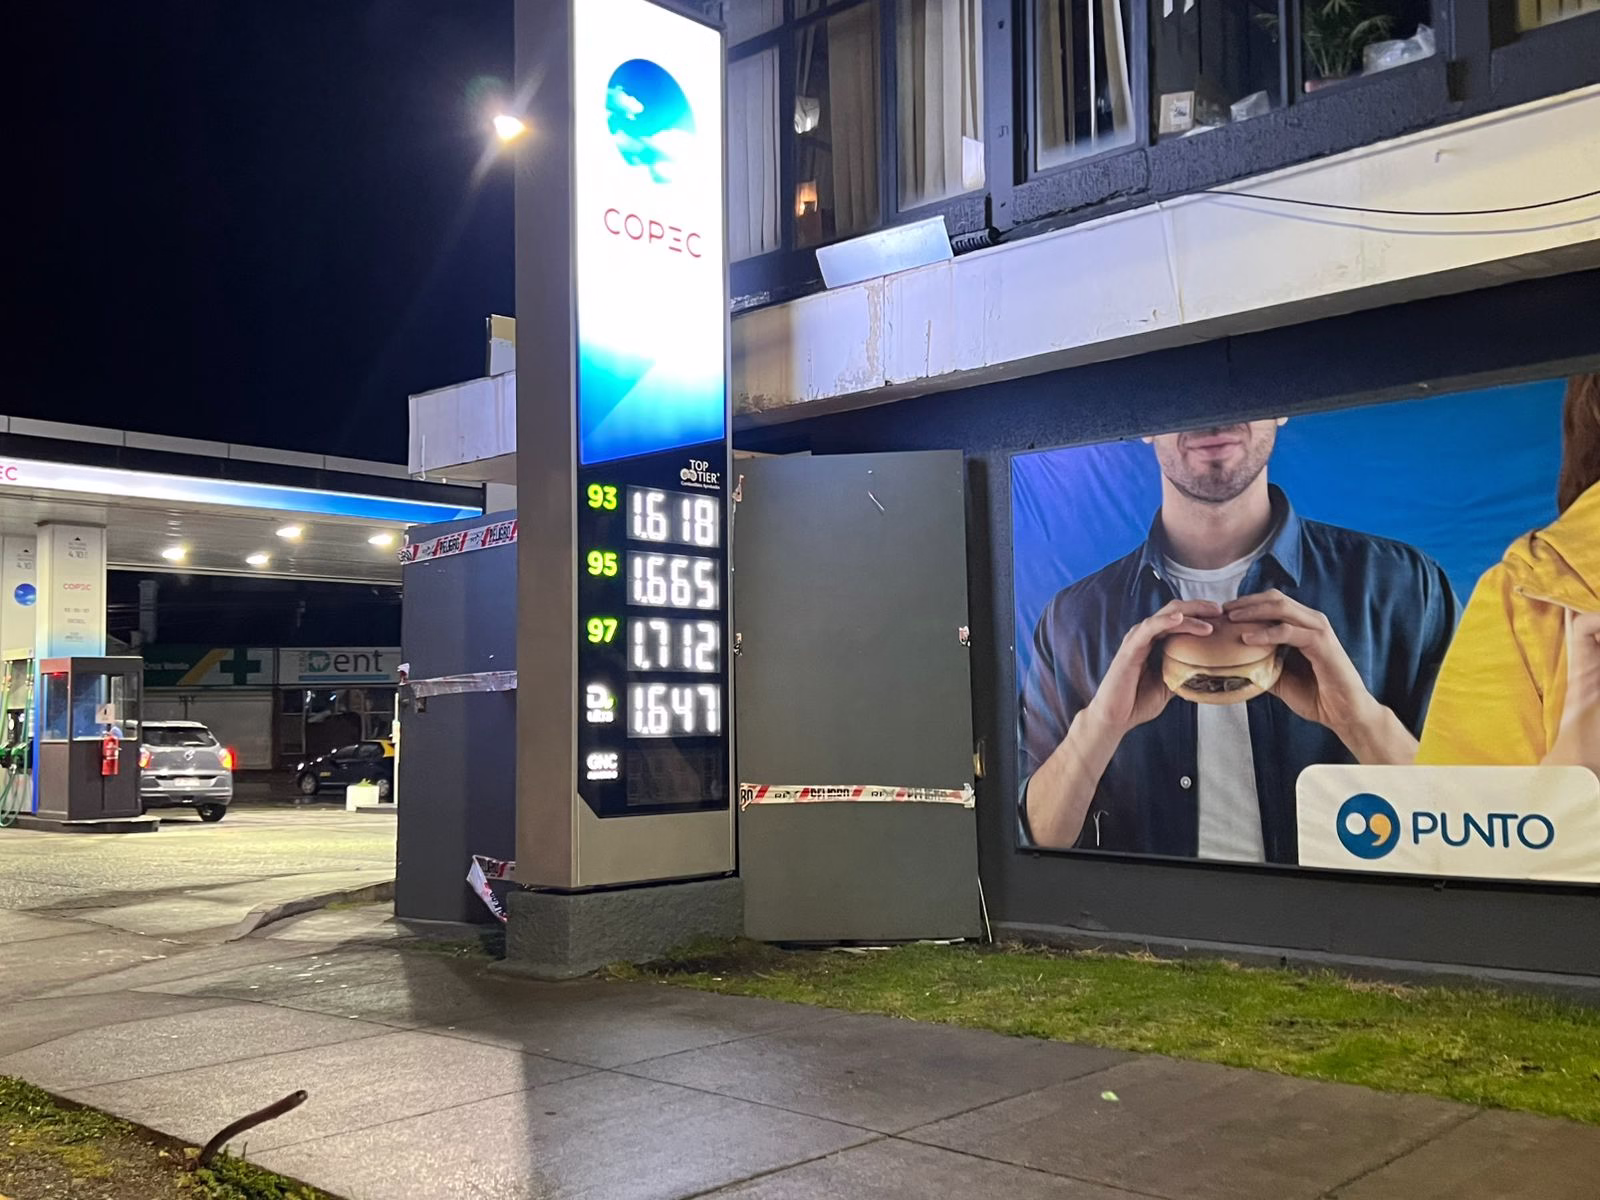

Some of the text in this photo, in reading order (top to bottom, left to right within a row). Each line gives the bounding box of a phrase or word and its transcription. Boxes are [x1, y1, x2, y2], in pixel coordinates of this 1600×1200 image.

[604, 208, 702, 258] COPEC
[689, 459, 709, 471] TOP
[697, 471, 718, 484] TIER
[587, 484, 714, 547] 93 1.618
[587, 550, 714, 608] 95 1.665
[587, 618, 714, 671] 97 1.712
[633, 686, 716, 734] 1.647
[1412, 811, 1555, 850] PUNTO
